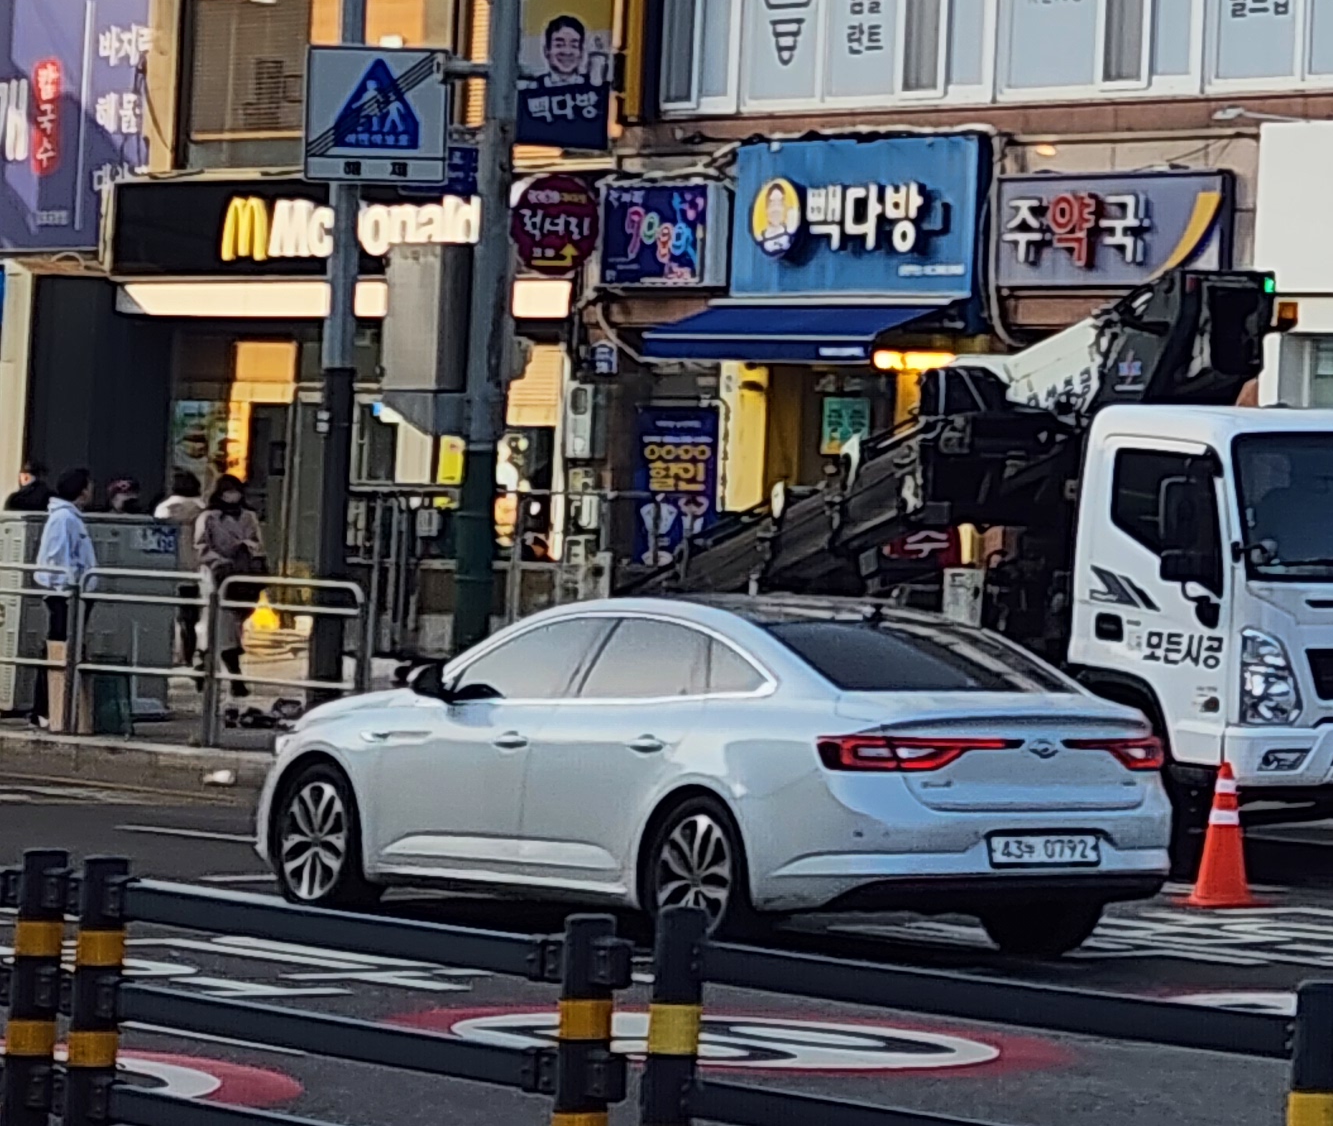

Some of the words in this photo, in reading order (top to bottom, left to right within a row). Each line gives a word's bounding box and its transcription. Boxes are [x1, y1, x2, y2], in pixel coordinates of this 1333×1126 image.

[846, 23, 885, 55] 란트
[527, 91, 599, 122] 빽다방
[267, 195, 482, 259] Mconald
[807, 179, 926, 255] 빽다방
[1001, 193, 1152, 269] 주약국
[1141, 629, 1225, 671] 모든시공
[1043, 838, 1089, 860] 0792
